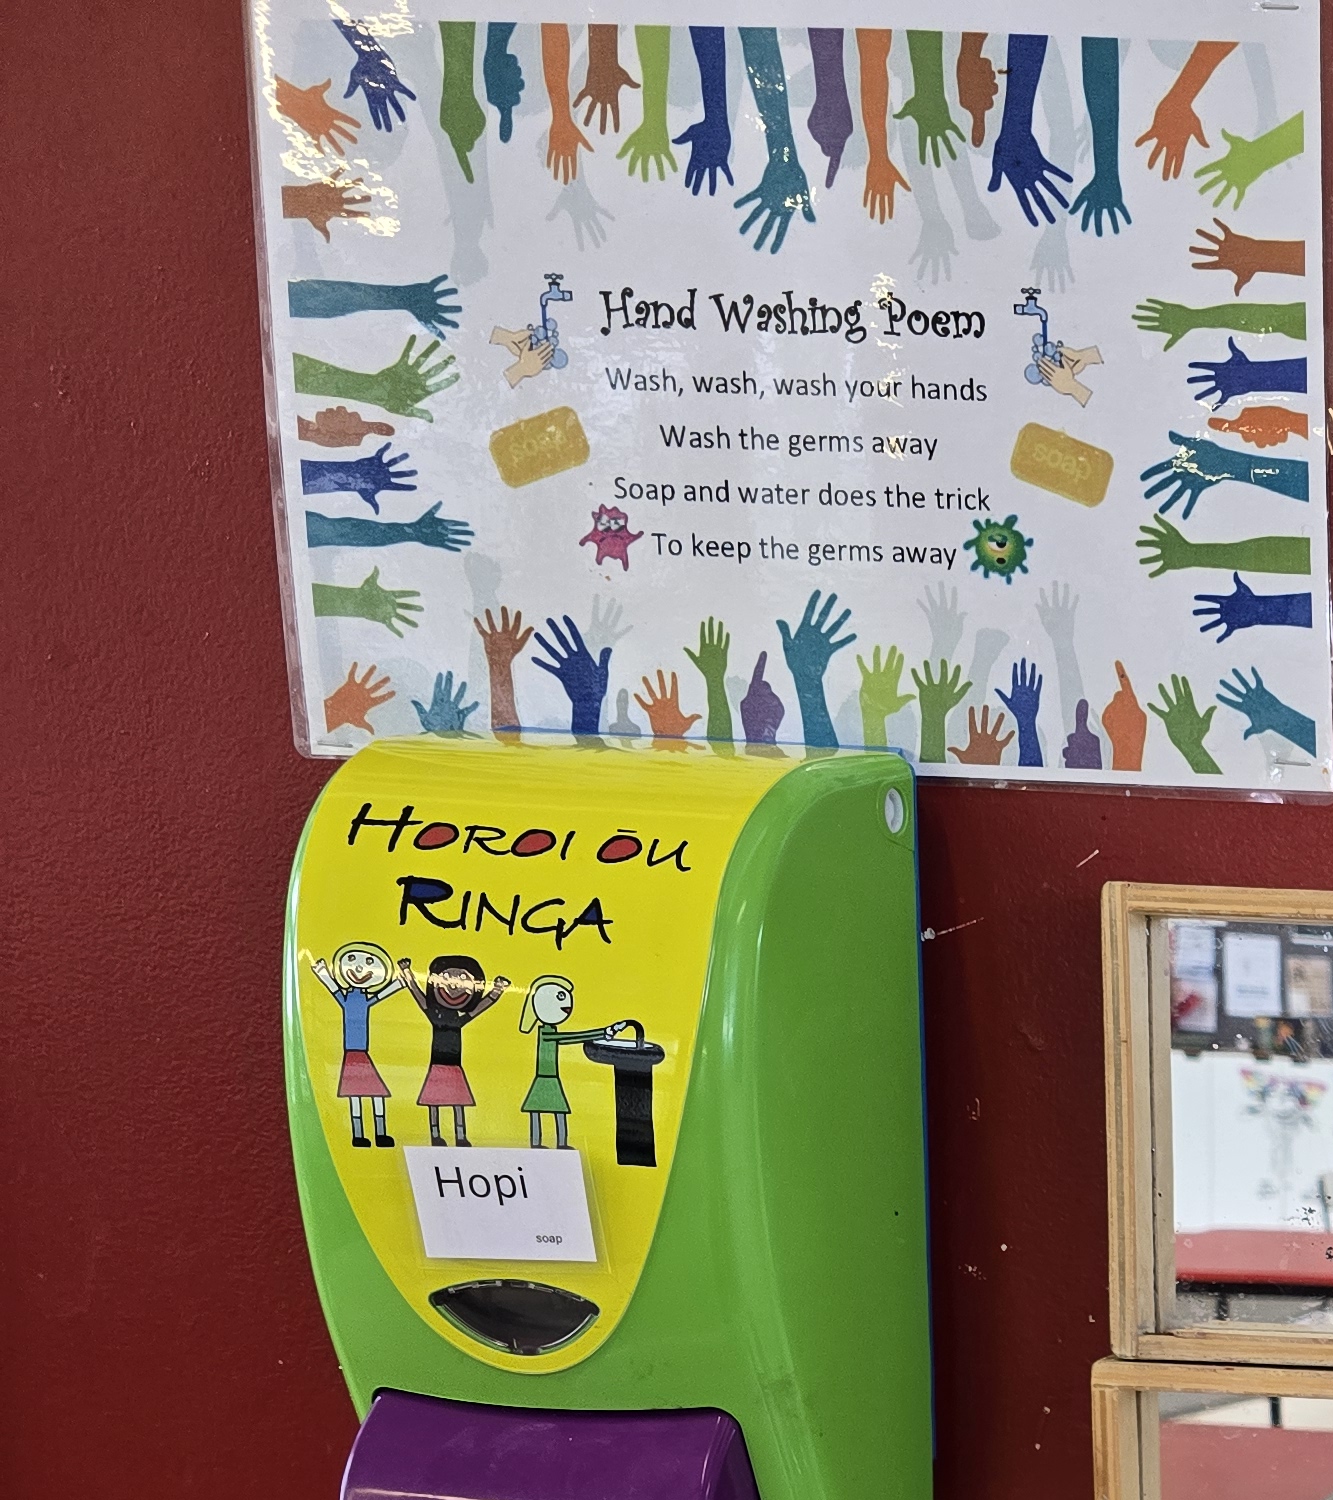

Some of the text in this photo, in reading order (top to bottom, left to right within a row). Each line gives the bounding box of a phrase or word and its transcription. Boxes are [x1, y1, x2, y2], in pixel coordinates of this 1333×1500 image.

[600, 287, 987, 344] Hand Washing Poem
[605, 367, 988, 403] Wash, wash, wash your hands
[659, 424, 938, 461] Wash the germs away
[1032, 443, 1092, 483] soap
[614, 476, 991, 512] Soap and water does the trick
[651, 533, 957, 570] To keep the germs away
[396, 875, 614, 950] RINGA
[434, 1166, 529, 1206] Hopi
[535, 1233, 563, 1247] soap
